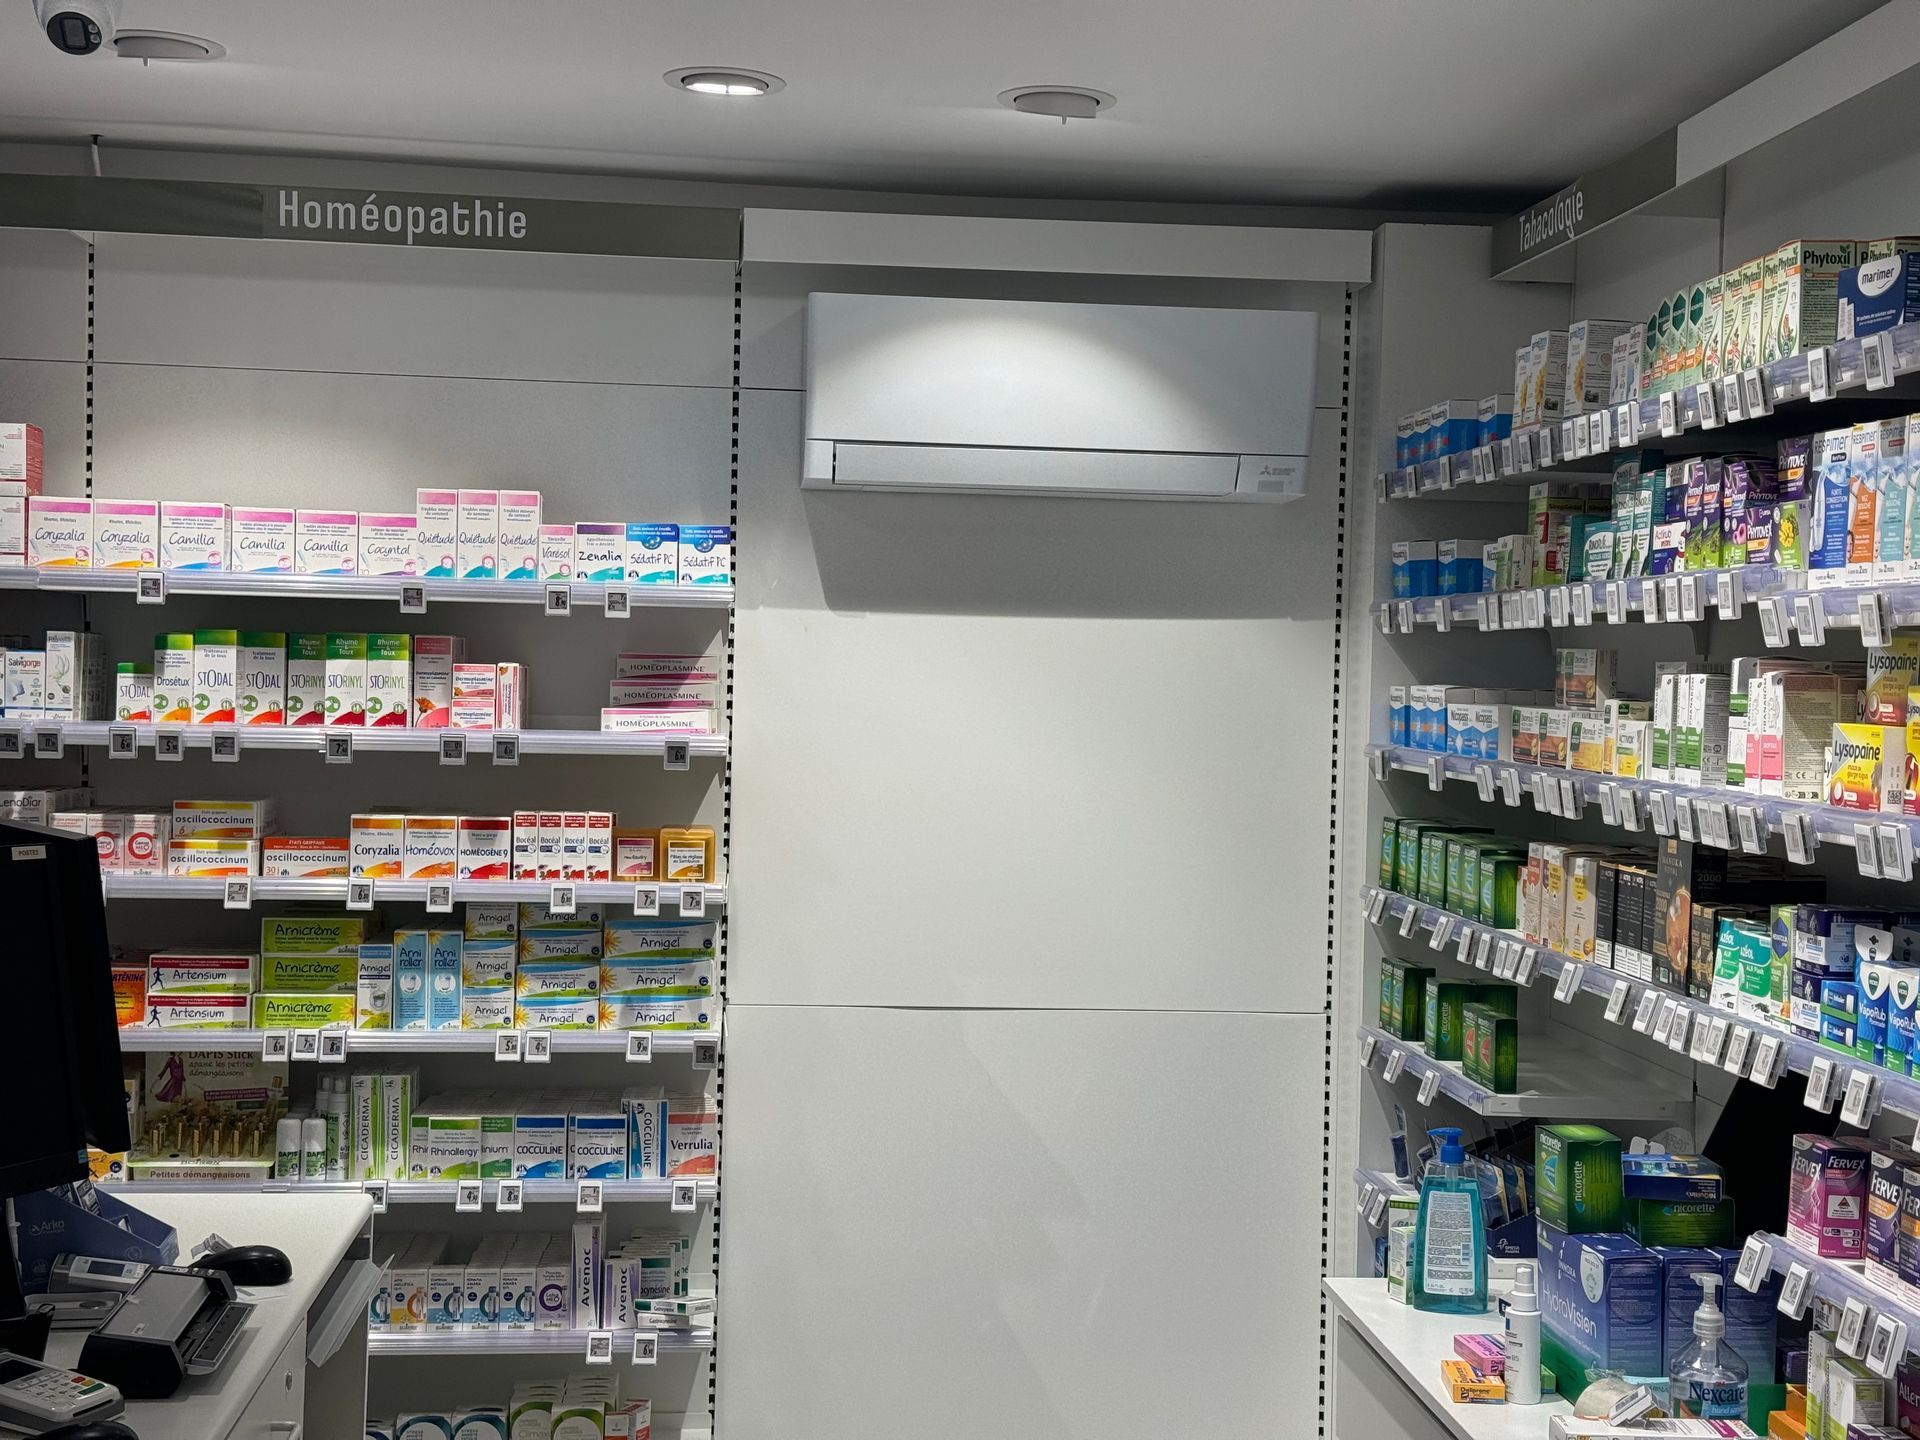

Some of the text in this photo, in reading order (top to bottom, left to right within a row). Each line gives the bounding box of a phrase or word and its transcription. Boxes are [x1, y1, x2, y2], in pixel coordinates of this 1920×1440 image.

[279, 190, 526, 245] Homéopathie
[1519, 185, 1583, 253] Tabacologie
[1803, 249, 1850, 269] Phytoxil
[1861, 266, 1895, 286] marimer
[35, 527, 85, 544] Coryzalia
[100, 529, 150, 545] Coryzalia
[168, 532, 216, 546] Camilia
[418, 531, 455, 545] Quiétude
[459, 531, 496, 545] Quiétude
[500, 532, 537, 546] Quiétude
[240, 536, 285, 550] Camilia
[303, 539, 349, 552] Camilia
[367, 543, 411, 558] Cocyntal
[579, 550, 622, 561] Zenalia
[630, 553, 673, 565] Sédatif PC
[683, 556, 726, 568] Sédatif PC
[299, 638, 320, 646] Rhume
[336, 638, 358, 646] Rhume
[8, 656, 41, 670] Salvigorge
[630, 662, 706, 673] HOMÉOPLASMINE
[156, 676, 190, 687] Drosétux
[624, 690, 702, 701] HOMÉOPLASMINE
[616, 717, 696, 727] HOMÉOPLASMINE
[175, 814, 254, 826] oscillococcinum
[516, 836, 536, 845] Bocéal
[540, 836, 560, 845] Bocéal
[564, 836, 585, 845] Bocéal
[588, 836, 609, 845] Bocéal
[354, 844, 400, 858] Coryzalia
[406, 843, 455, 857] Homéovox
[460, 846, 508, 858] HOMÉOGÈNE 9
[170, 854, 249, 865] oscillococcinum
[266, 852, 347, 863] oscillococcinum
[478, 912, 511, 924] Arnigel
[543, 911, 577, 923] Arnigel
[275, 923, 340, 937] Arnicrème
[543, 943, 579, 956] Arnigel
[641, 937, 680, 950] Arnigel
[400, 947, 422, 957] Arni
[434, 947, 456, 957] Arni
[274, 961, 340, 974] Arnicrème
[360, 963, 391, 975] Arnigel
[399, 957, 424, 968] roller
[434, 957, 458, 968] roller
[475, 960, 508, 972] Arnigel
[173, 969, 227, 982] Artensium
[636, 974, 676, 987] Arnigel
[540, 979, 576, 991] Arnigel
[169, 1007, 225, 1020] Artensium
[266, 1000, 333, 1014] Arnicrème
[475, 1004, 507, 1016] Arnigel
[1858, 1002, 1887, 1021] VapoRub
[539, 1013, 574, 1025] Arnigel
[635, 1011, 675, 1024] Arnigel
[189, 1050, 254, 1059] DAPIS Stick
[189, 1061, 213, 1070] apaise
[228, 1060, 254, 1069] petites
[189, 1069, 244, 1079] démangeaisons
[361, 1097, 370, 1161] CICADERMA
[391, 1097, 400, 1160] CICADERMA
[643, 1112, 653, 1169] COCCULINE
[671, 1139, 713, 1151] Verrulia
[1540, 1133, 1562, 1152] nicorette
[430, 1146, 478, 1158] Rhinallergy
[516, 1143, 564, 1155] COCCULINE
[577, 1143, 624, 1155] COCCULINE
[1793, 1150, 1822, 1182] FERVEX
[1828, 1156, 1865, 1171] FERVEX
[150, 1170, 251, 1181] Petites démangeaisons
[1575, 1160, 1583, 1202] nicorette
[1673, 1203, 1715, 1213] nicorette
[41, 1219, 65, 1232] Arko
[581, 1248, 591, 1307] Avenoc
[618, 1267, 628, 1323] Avenoc
[1543, 1284, 1597, 1339] HydroVision
[1689, 1380, 1745, 1405] Nexcare
